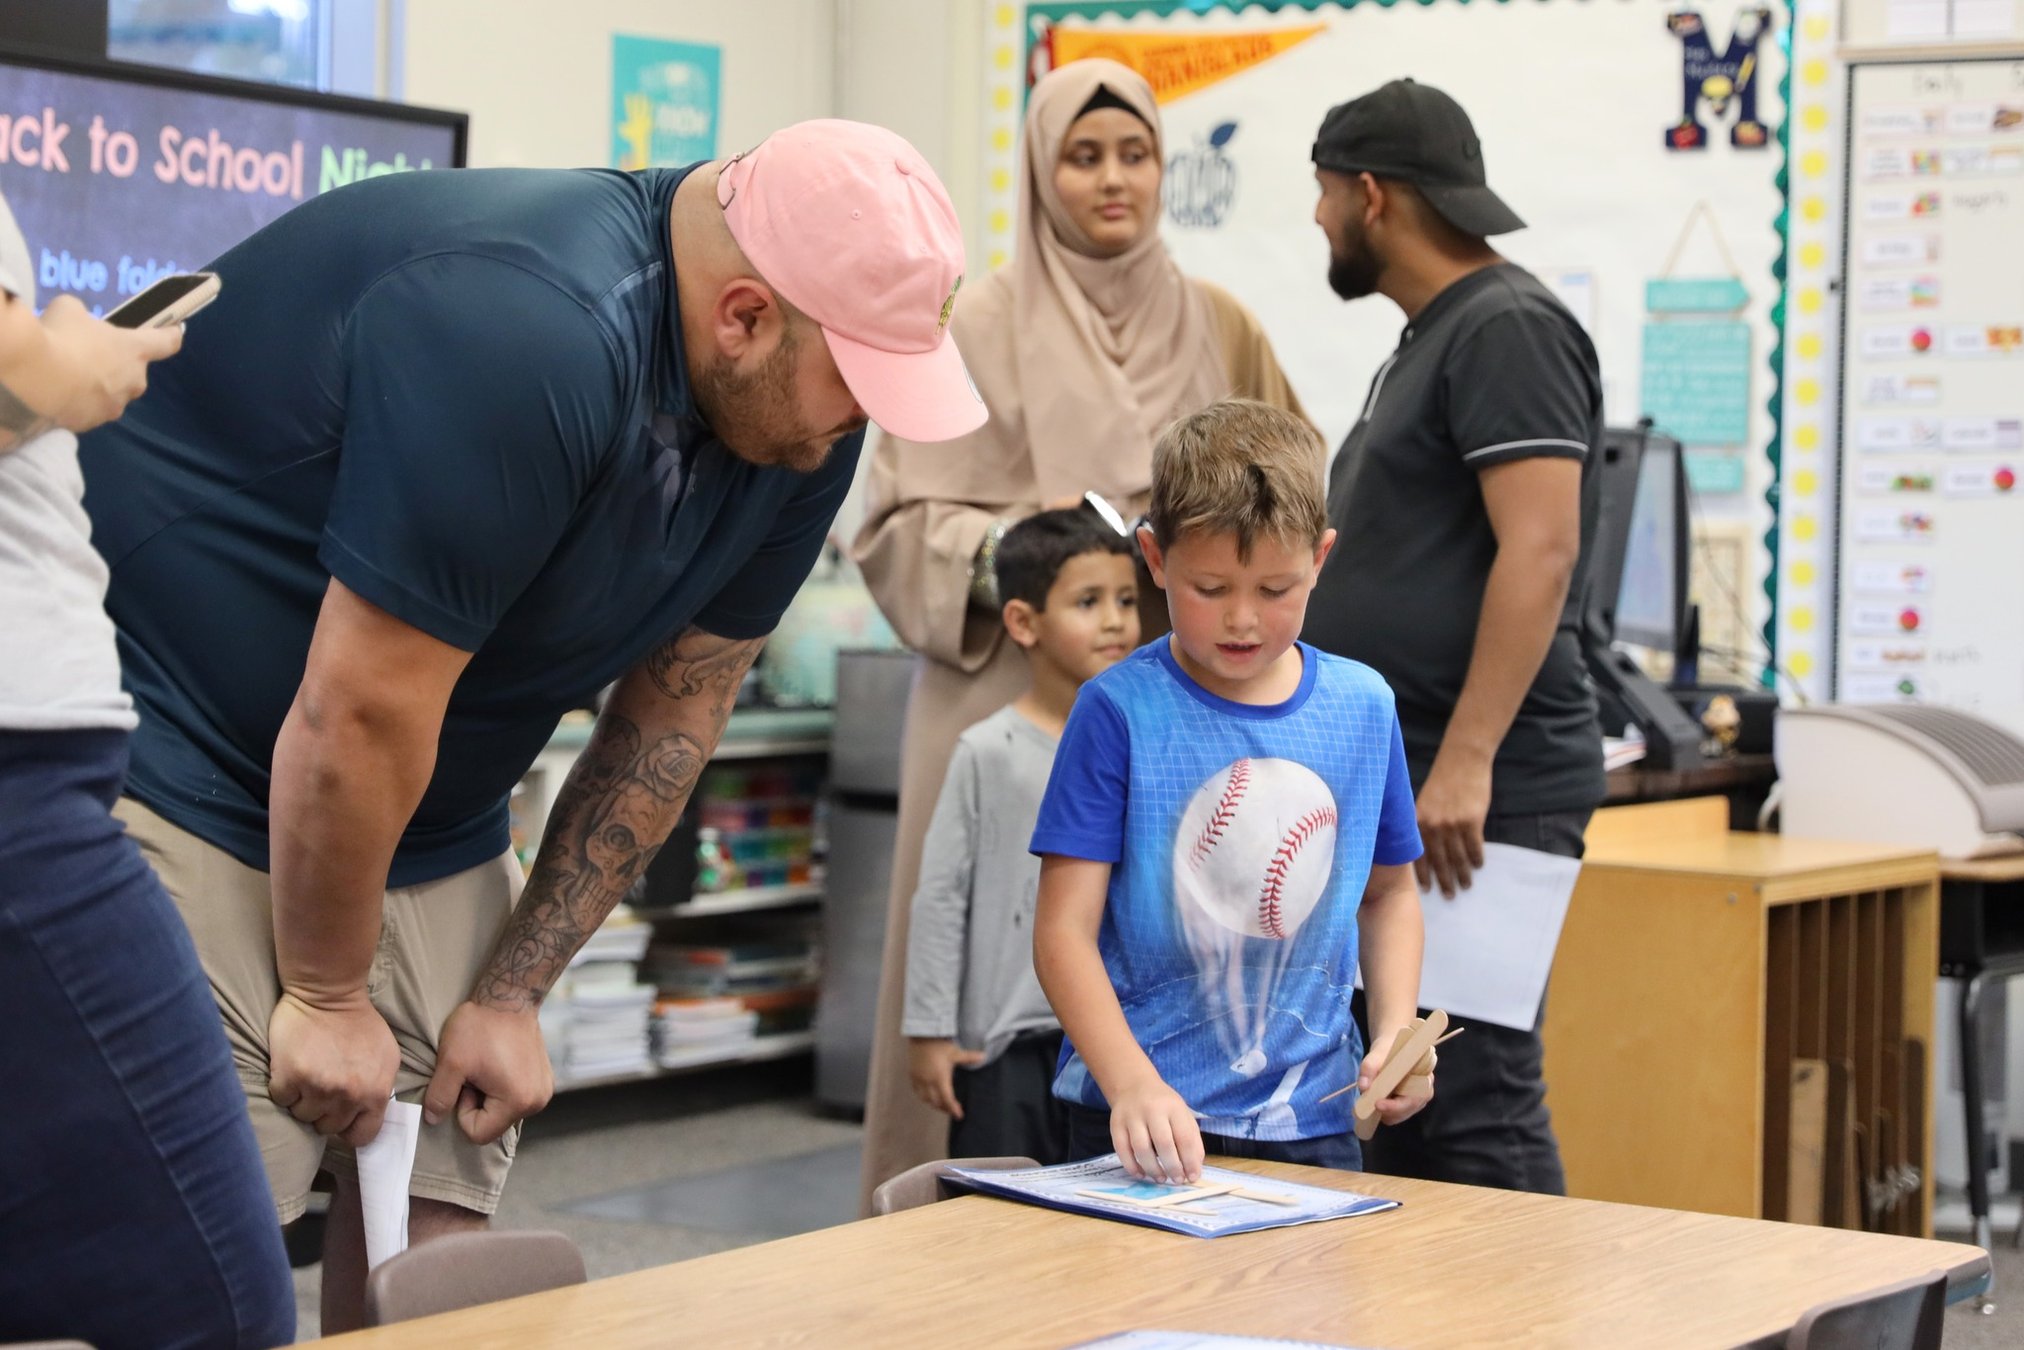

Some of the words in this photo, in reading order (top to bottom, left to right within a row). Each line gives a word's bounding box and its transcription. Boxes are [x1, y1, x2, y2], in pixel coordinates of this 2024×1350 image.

[88, 115, 139, 178] to
[153, 125, 305, 200] School
[40, 247, 108, 292] blue
